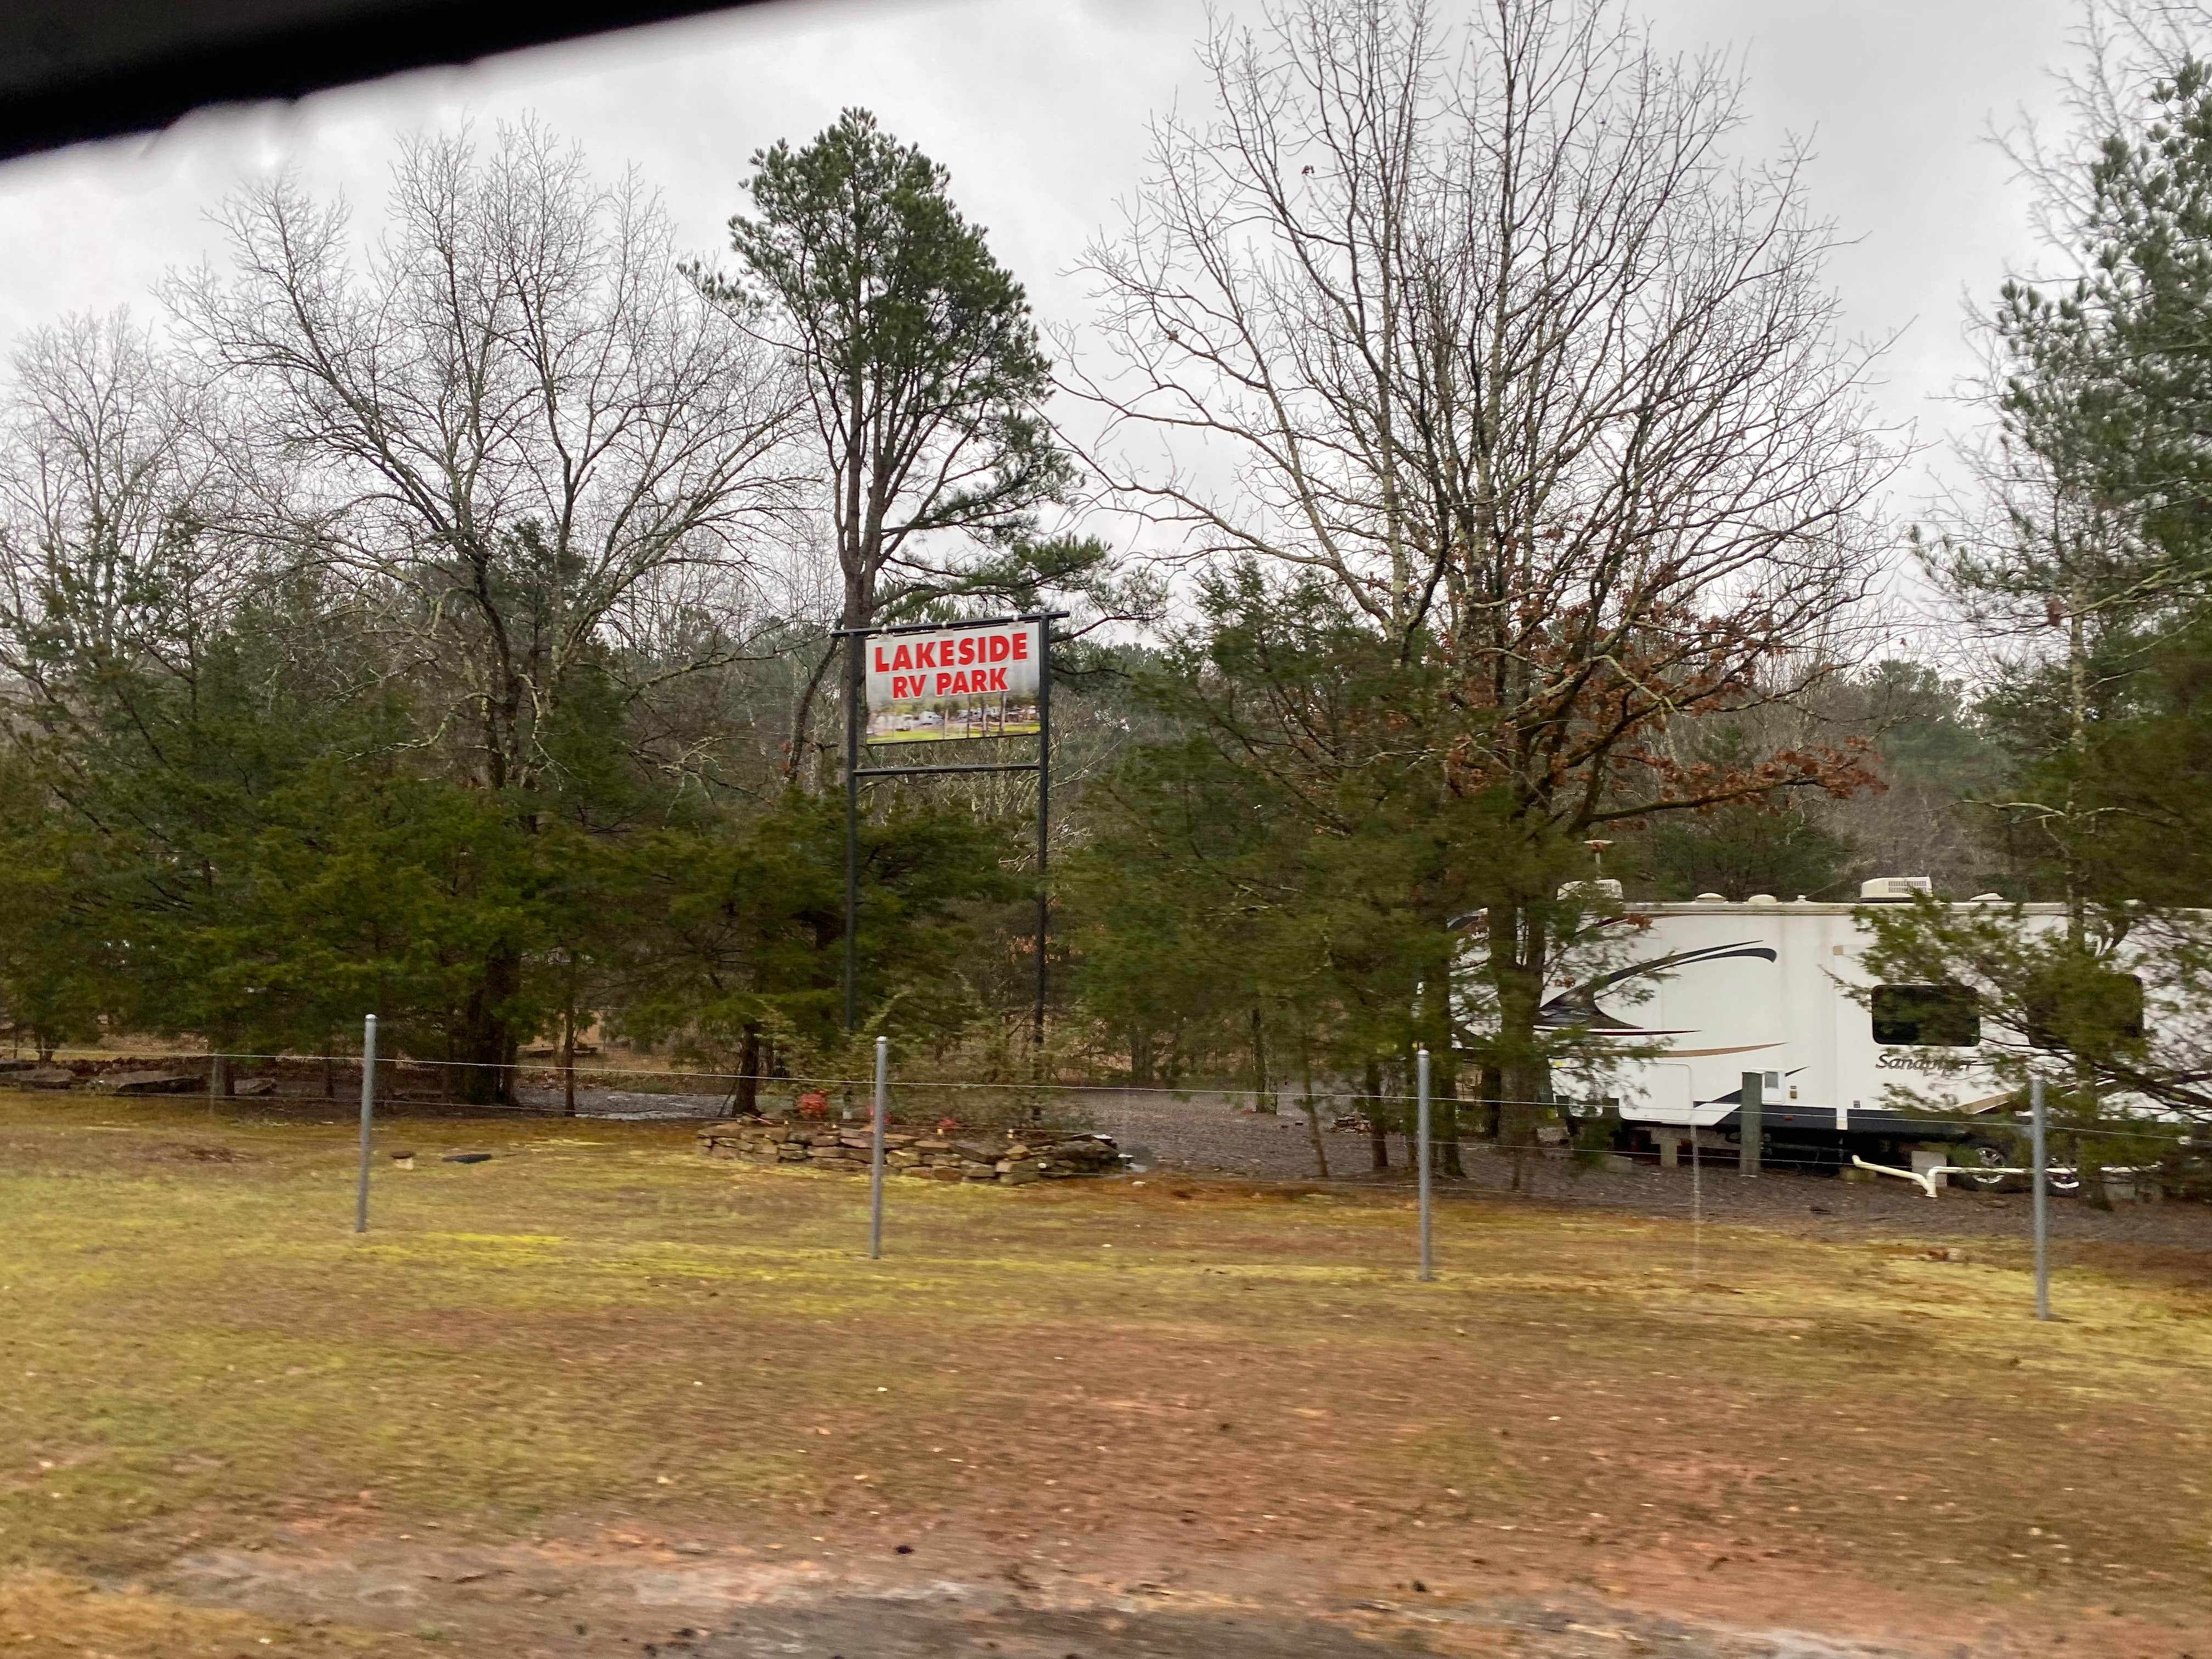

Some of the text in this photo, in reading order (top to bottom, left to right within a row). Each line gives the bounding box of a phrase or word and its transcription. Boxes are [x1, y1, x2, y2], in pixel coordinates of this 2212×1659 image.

[875, 633, 1028, 673] LAKESIDE
[892, 667, 1008, 699] RV PARK
